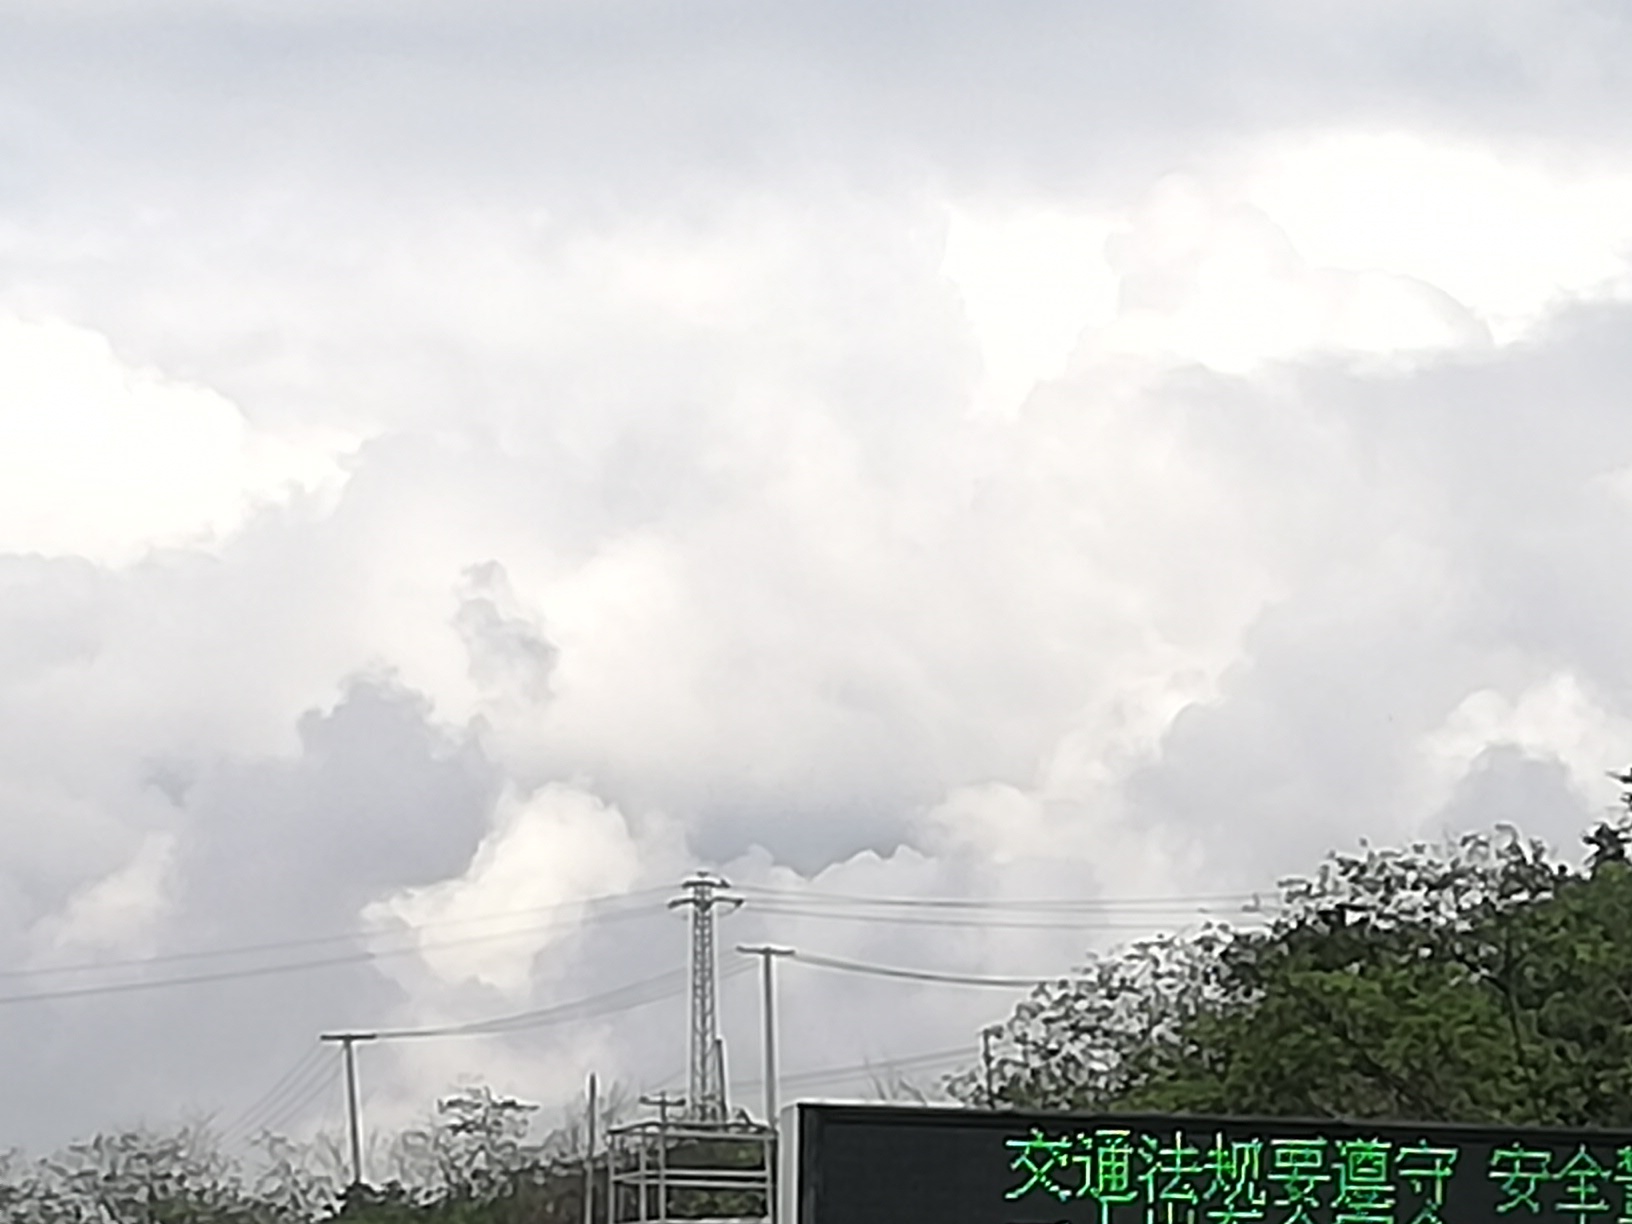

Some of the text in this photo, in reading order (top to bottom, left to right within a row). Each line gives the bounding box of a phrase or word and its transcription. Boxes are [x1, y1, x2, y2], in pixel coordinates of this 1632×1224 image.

[1005, 1128, 1458, 1206] 交通法规要遵守
